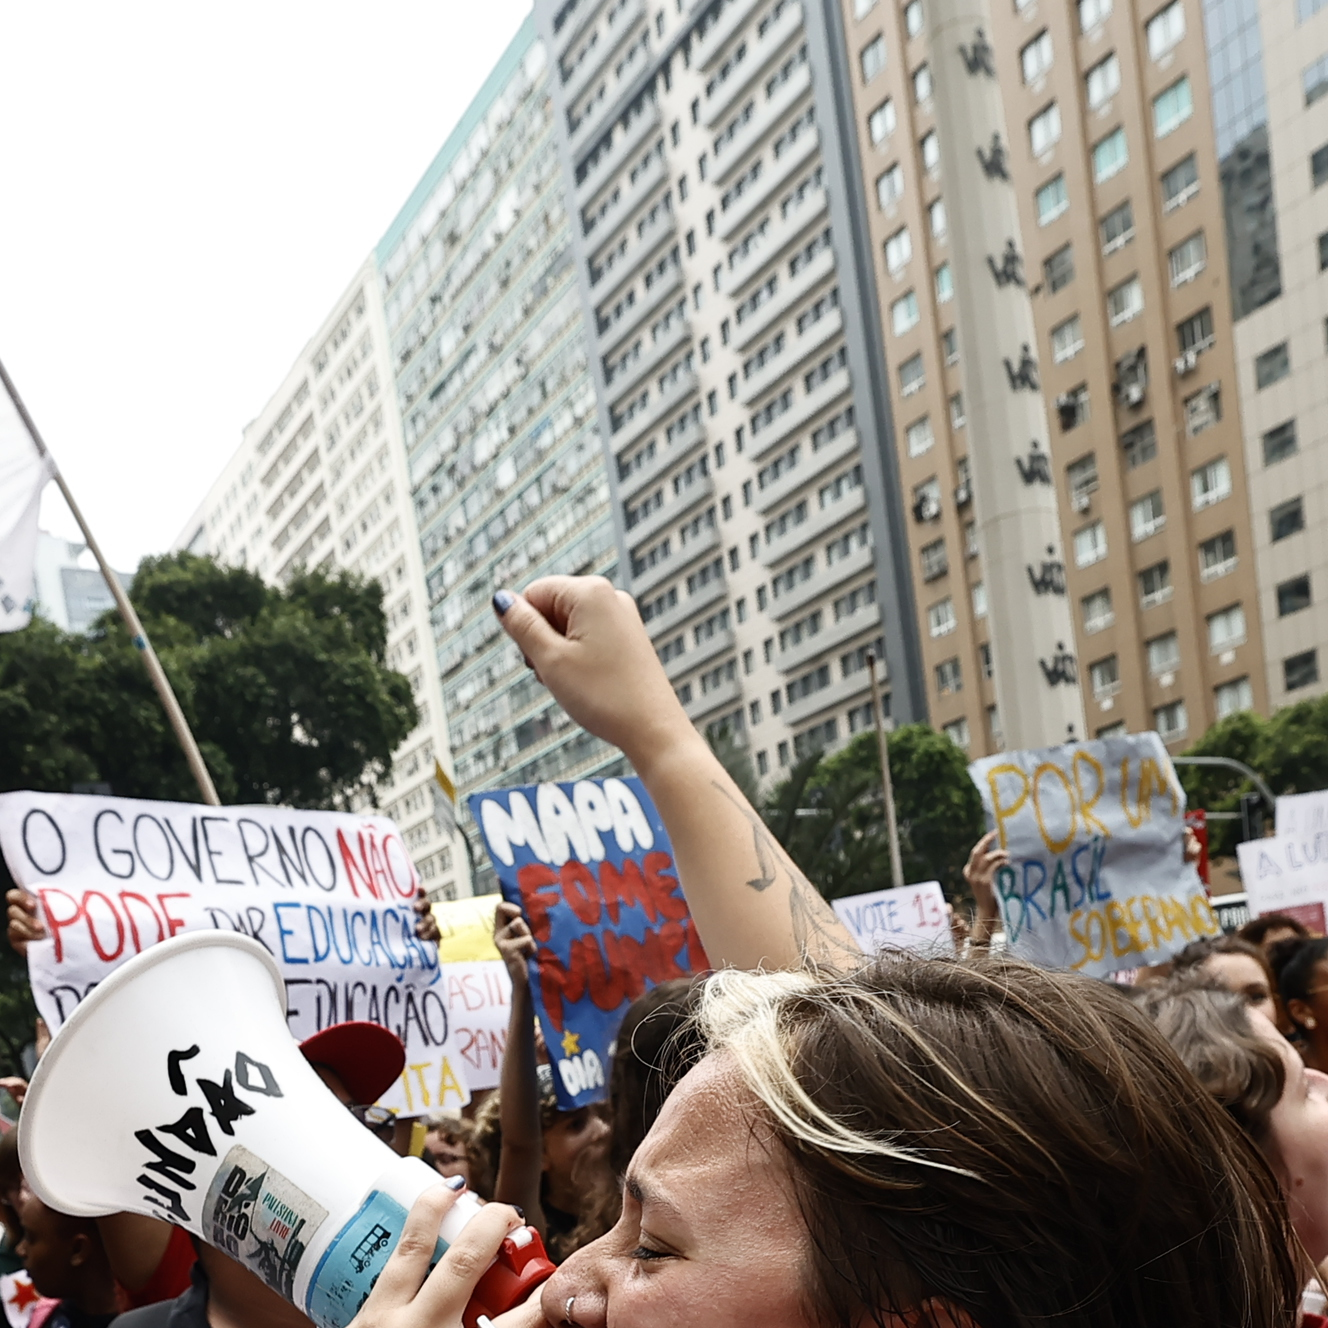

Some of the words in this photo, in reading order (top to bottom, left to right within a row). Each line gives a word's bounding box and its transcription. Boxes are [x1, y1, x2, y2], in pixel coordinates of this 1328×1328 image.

[481, 777, 654, 867] MAPA
[987, 750, 1112, 854] POR
[21, 808, 66, 876] O
[93, 809, 336, 892] GOVERNO
[336, 822, 416, 900] NÃO
[517, 851, 690, 942] FOME
[997, 834, 1112, 944] BRASIL
[272, 902, 442, 986] EDUCAÇÃO
[844, 900, 904, 937] VOTE
[912, 892, 945, 929] 13
[1068, 895, 1219, 971] SOBERANO
[262, 1192, 300, 1229] PALESTINA
